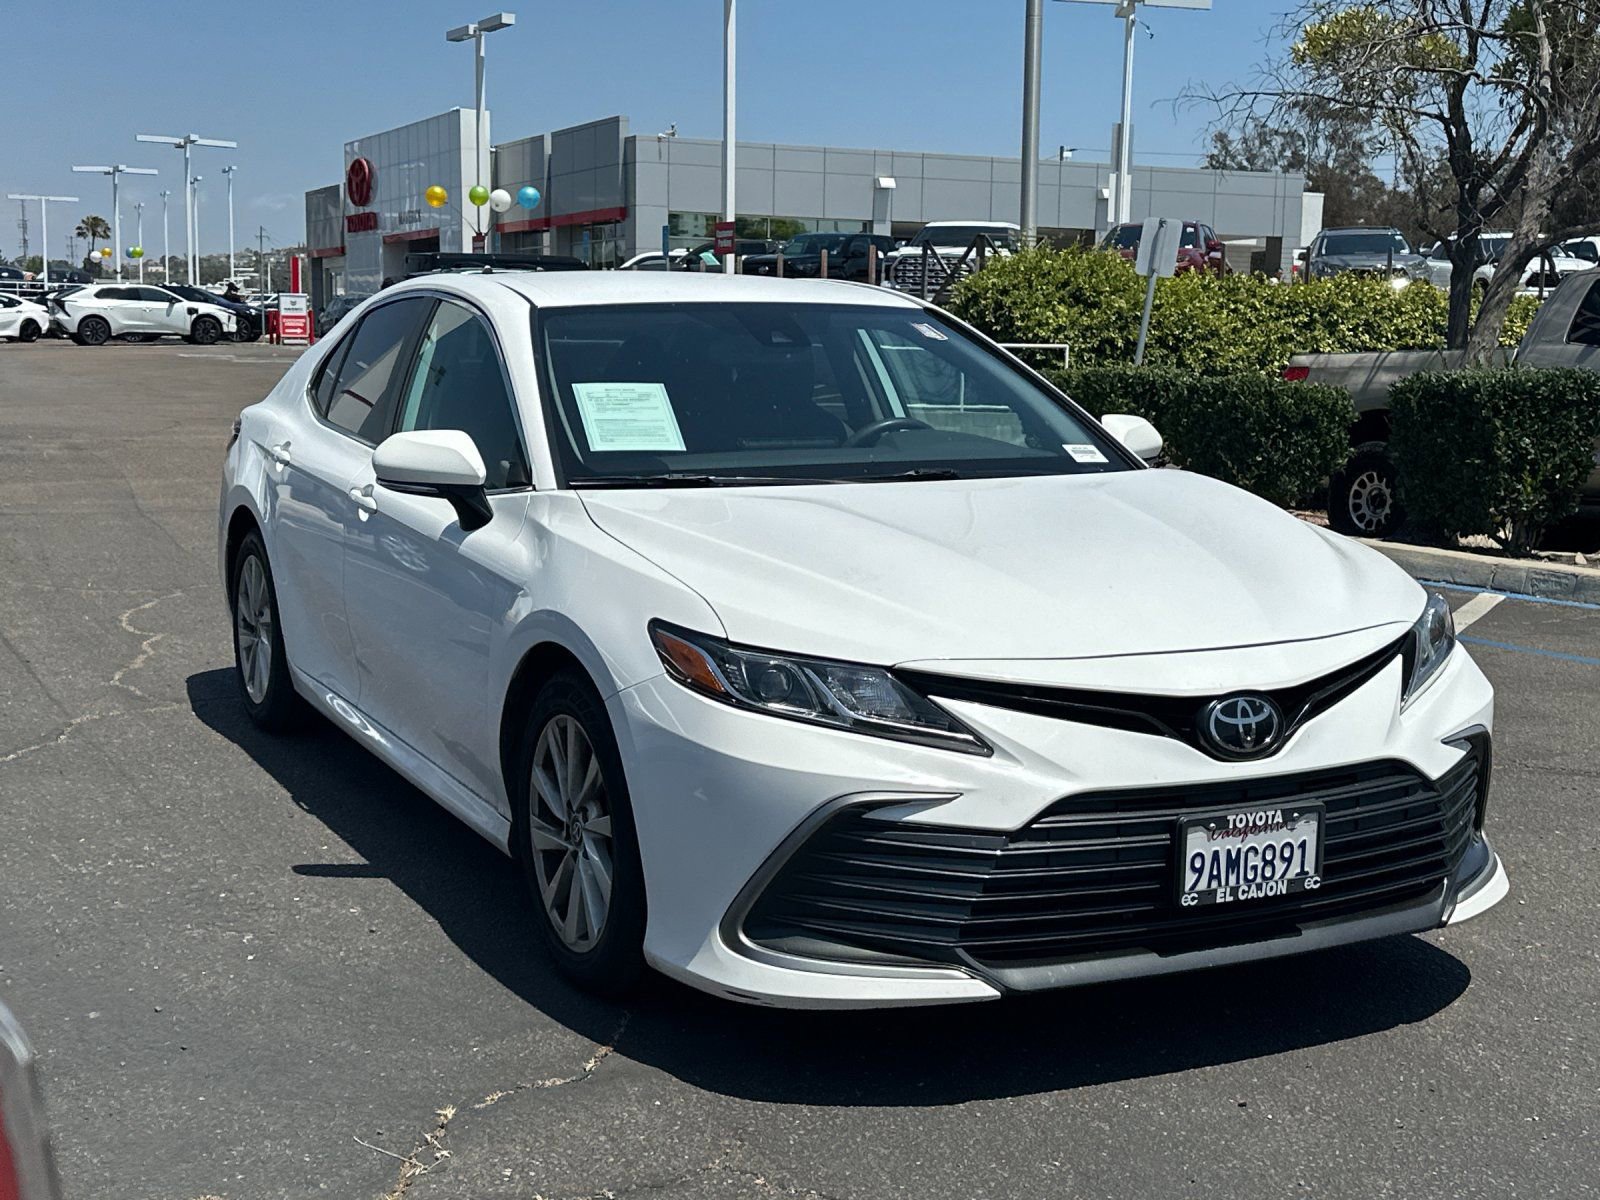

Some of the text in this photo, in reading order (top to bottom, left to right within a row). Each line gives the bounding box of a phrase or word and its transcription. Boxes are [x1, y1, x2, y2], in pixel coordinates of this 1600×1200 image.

[1227, 809, 1283, 829] TOYOTA
[1188, 838, 1310, 892] 9AMG891
[1216, 880, 1288, 903] EL CAJON
